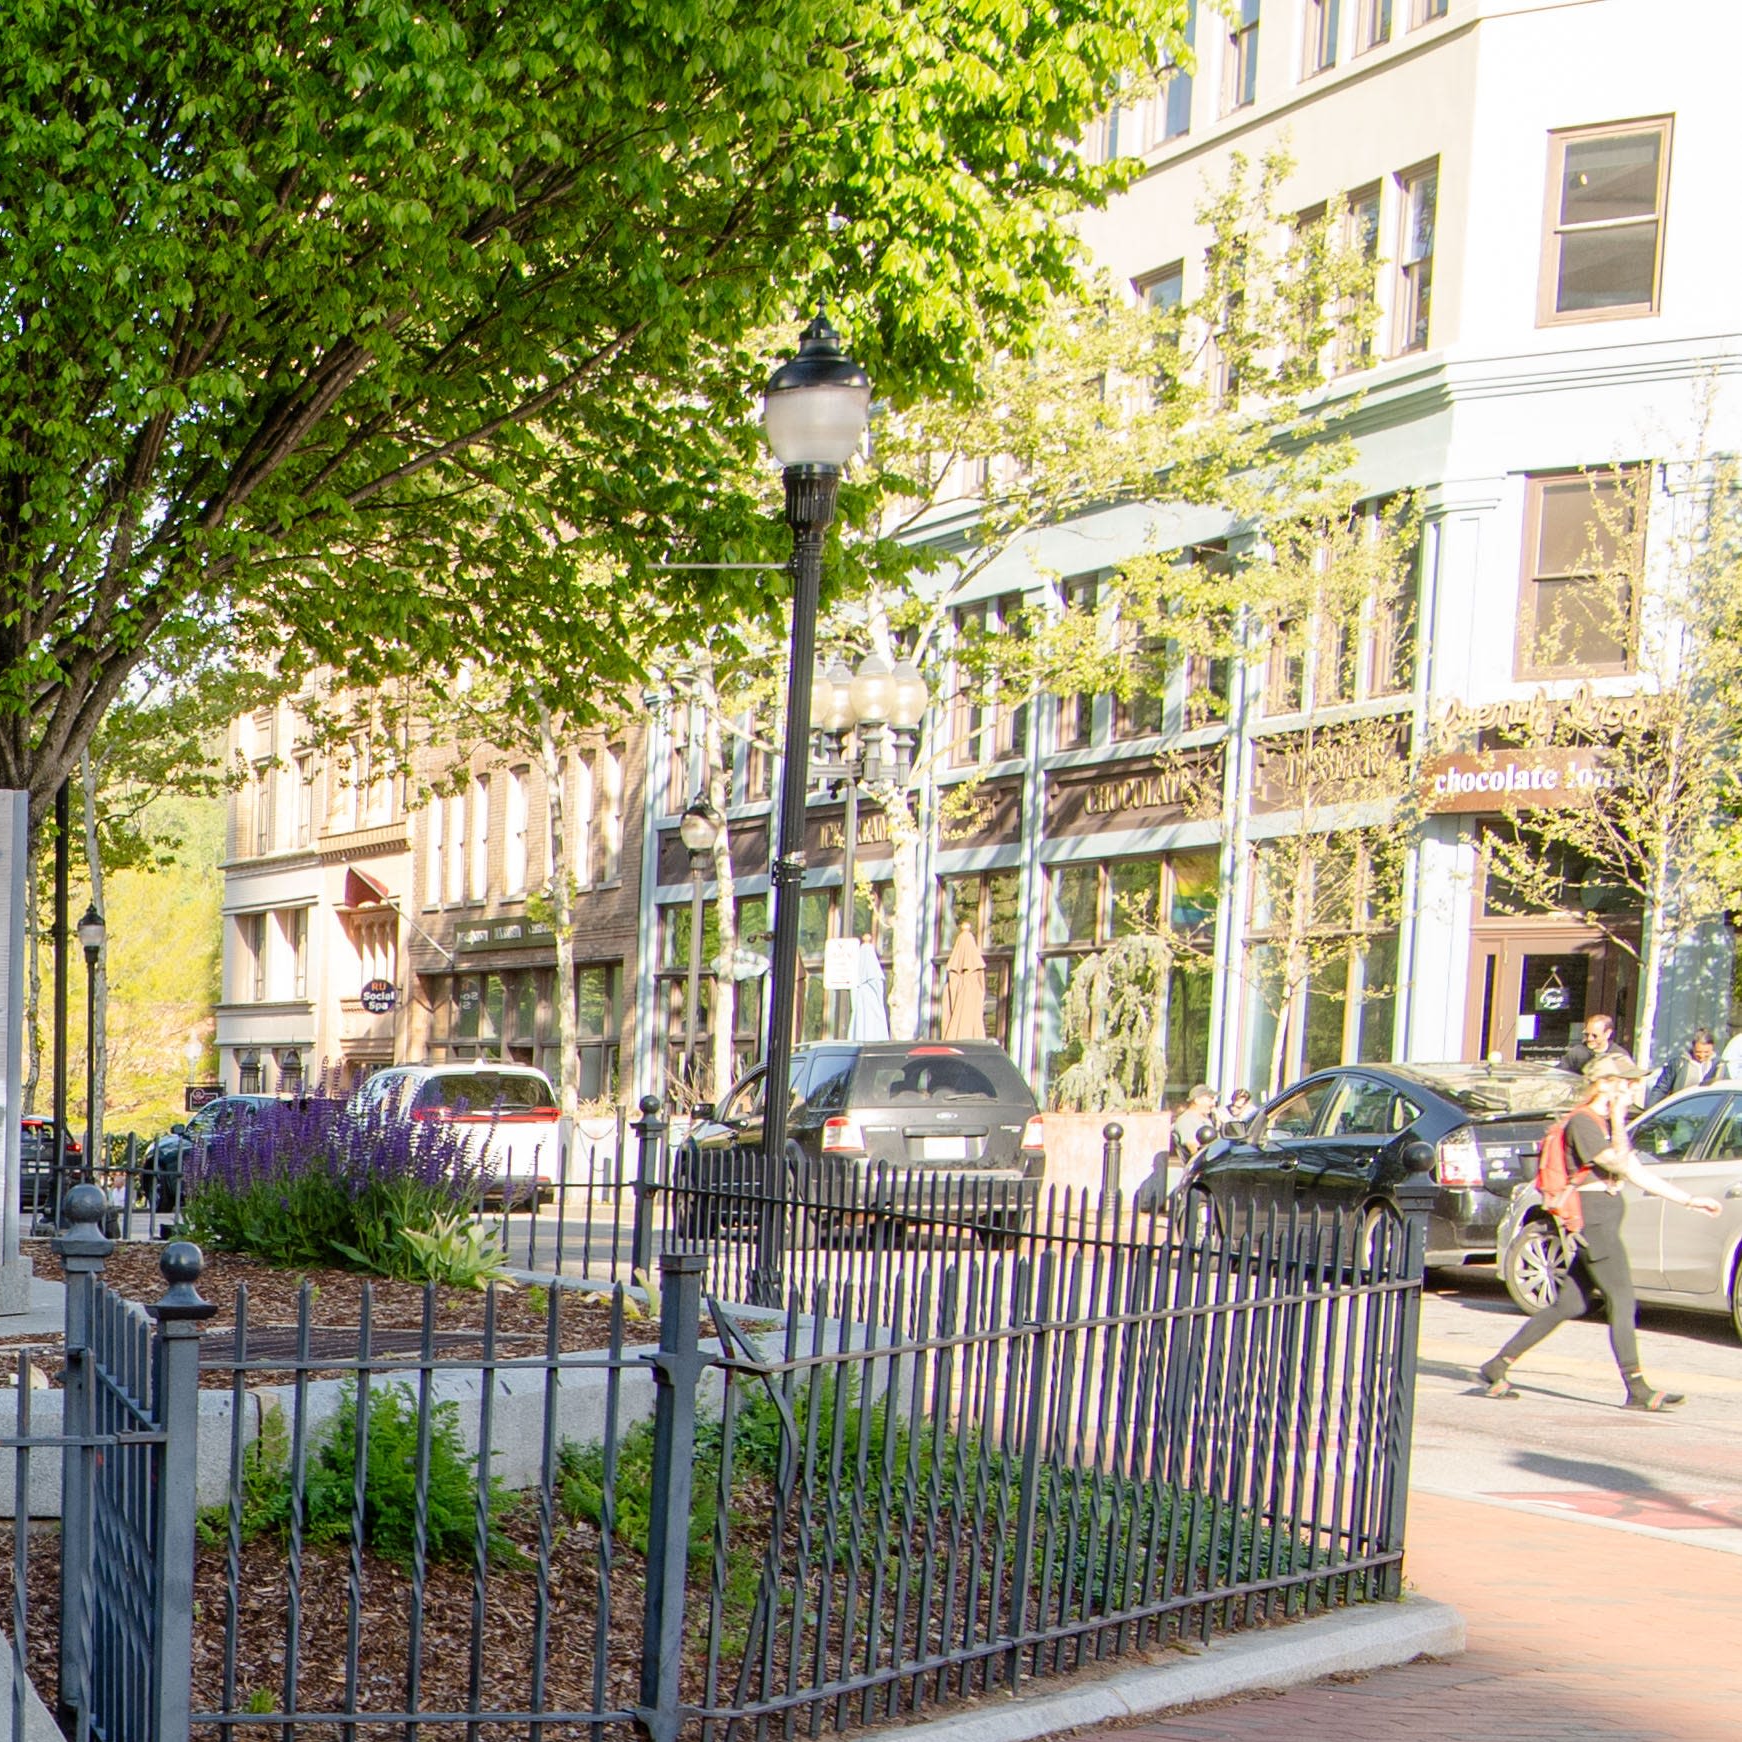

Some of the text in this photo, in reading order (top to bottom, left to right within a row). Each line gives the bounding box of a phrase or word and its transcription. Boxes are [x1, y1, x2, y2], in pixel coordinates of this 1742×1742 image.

[1435, 763, 1557, 793] chocolate
[363, 991, 395, 1001] Social
[368, 1001, 389, 1011] Spa
